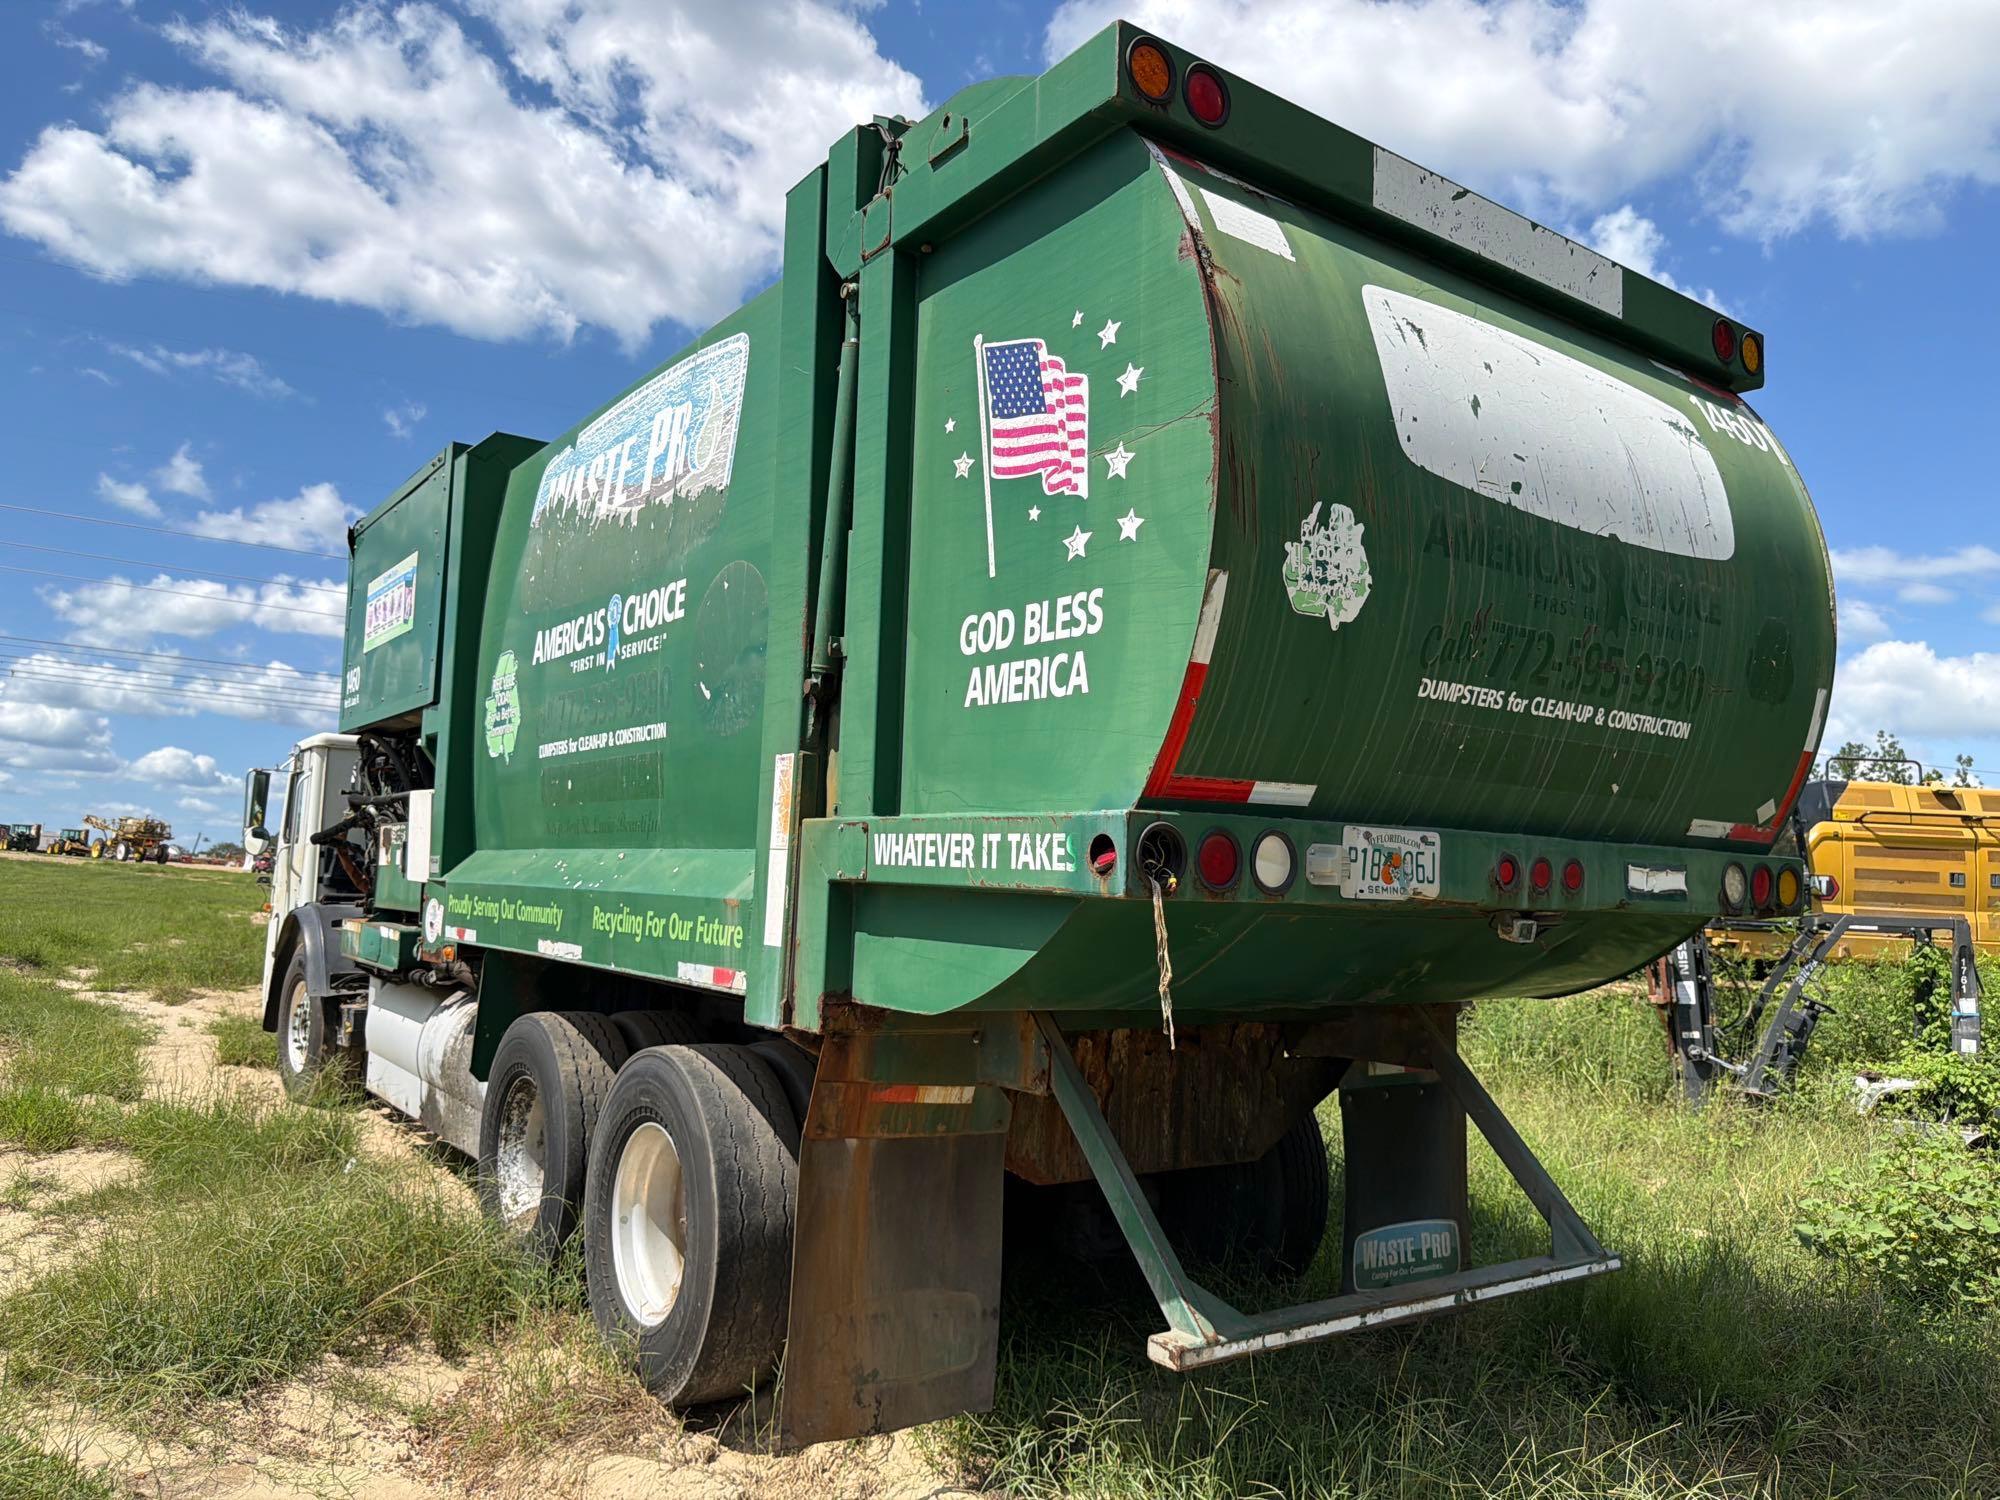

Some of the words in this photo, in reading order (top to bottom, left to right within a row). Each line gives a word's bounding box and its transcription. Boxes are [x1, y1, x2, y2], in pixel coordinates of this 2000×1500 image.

[1689, 394, 1788, 466] 14601
[532, 607, 606, 666] AMERICA'S
[622, 578, 687, 636] CHOICE
[959, 608, 1015, 655] GOD
[1023, 588, 1104, 646] BLESS
[596, 652, 605, 666] IN
[964, 651, 1089, 708] AMERICA
[1418, 677, 1505, 711] DUMPSTERS
[1507, 692, 1528, 713] for
[1531, 696, 1594, 726] CLEAN-UP
[1595, 707, 1605, 726] &
[1608, 709, 1692, 740] CONSTRUCTION
[538, 738, 568, 759] DUMPSTERS
[569, 735, 578, 752] for
[578, 732, 608, 750] CLEAN-UP
[609, 730, 615, 747] &
[615, 722, 667, 746] CONSTRUCTION
[874, 833, 975, 869] WHATEVER
[982, 833, 1001, 869] IT
[1008, 833, 1077, 872] TAKES
[1368, 886, 1408, 895] SEMINO
[1810, 876, 1829, 896] AT
[448, 894, 472, 920] Proudly
[473, 895, 499, 924] Serving
[501, 899, 516, 919] Our
[516, 900, 563, 931] Community
[592, 905, 643, 943] Recycling
[646, 911, 665, 938] For
[669, 912, 691, 941] Our
[695, 915, 744, 949] Future
[1676, 941, 1690, 975] NISS
[1960, 957, 1968, 994] 1761
[1362, 1237, 1416, 1270] WASTE
[1420, 1231, 1451, 1260] PRO
